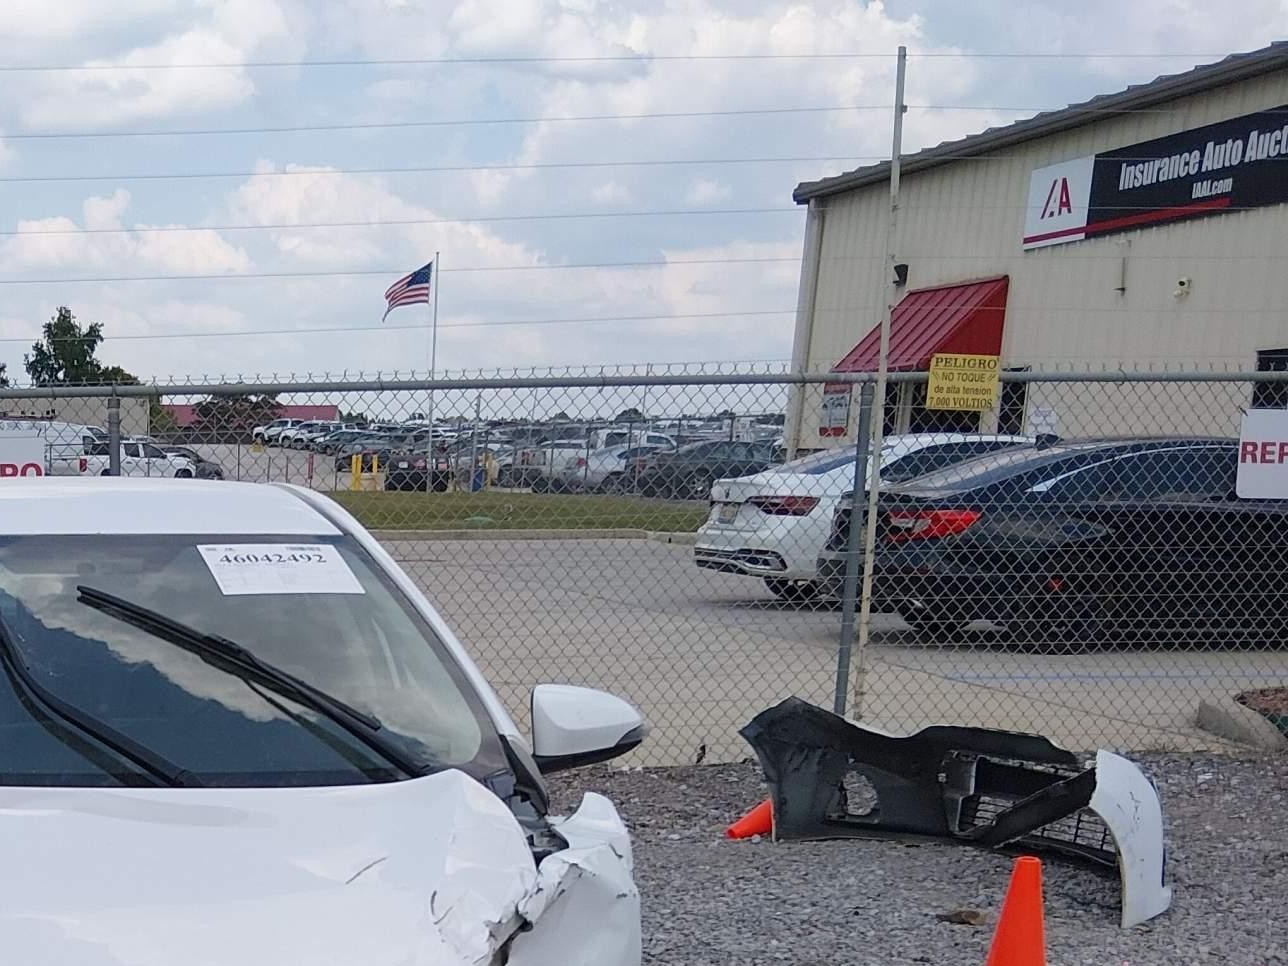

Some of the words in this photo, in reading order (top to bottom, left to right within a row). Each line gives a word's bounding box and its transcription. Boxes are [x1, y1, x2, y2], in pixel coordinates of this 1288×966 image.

[1119, 150, 1201, 191] Insurance
[1201, 139, 1244, 173] Auto
[934, 357, 998, 369] PELIGRO
[941, 372, 955, 382] NO
[957, 373, 986, 383] TOQUE
[934, 385, 945, 394] de
[946, 386, 961, 394] alta
[962, 386, 992, 396] tension
[953, 397, 993, 409] VOLTIOS
[219, 553, 328, 564] 46042492
